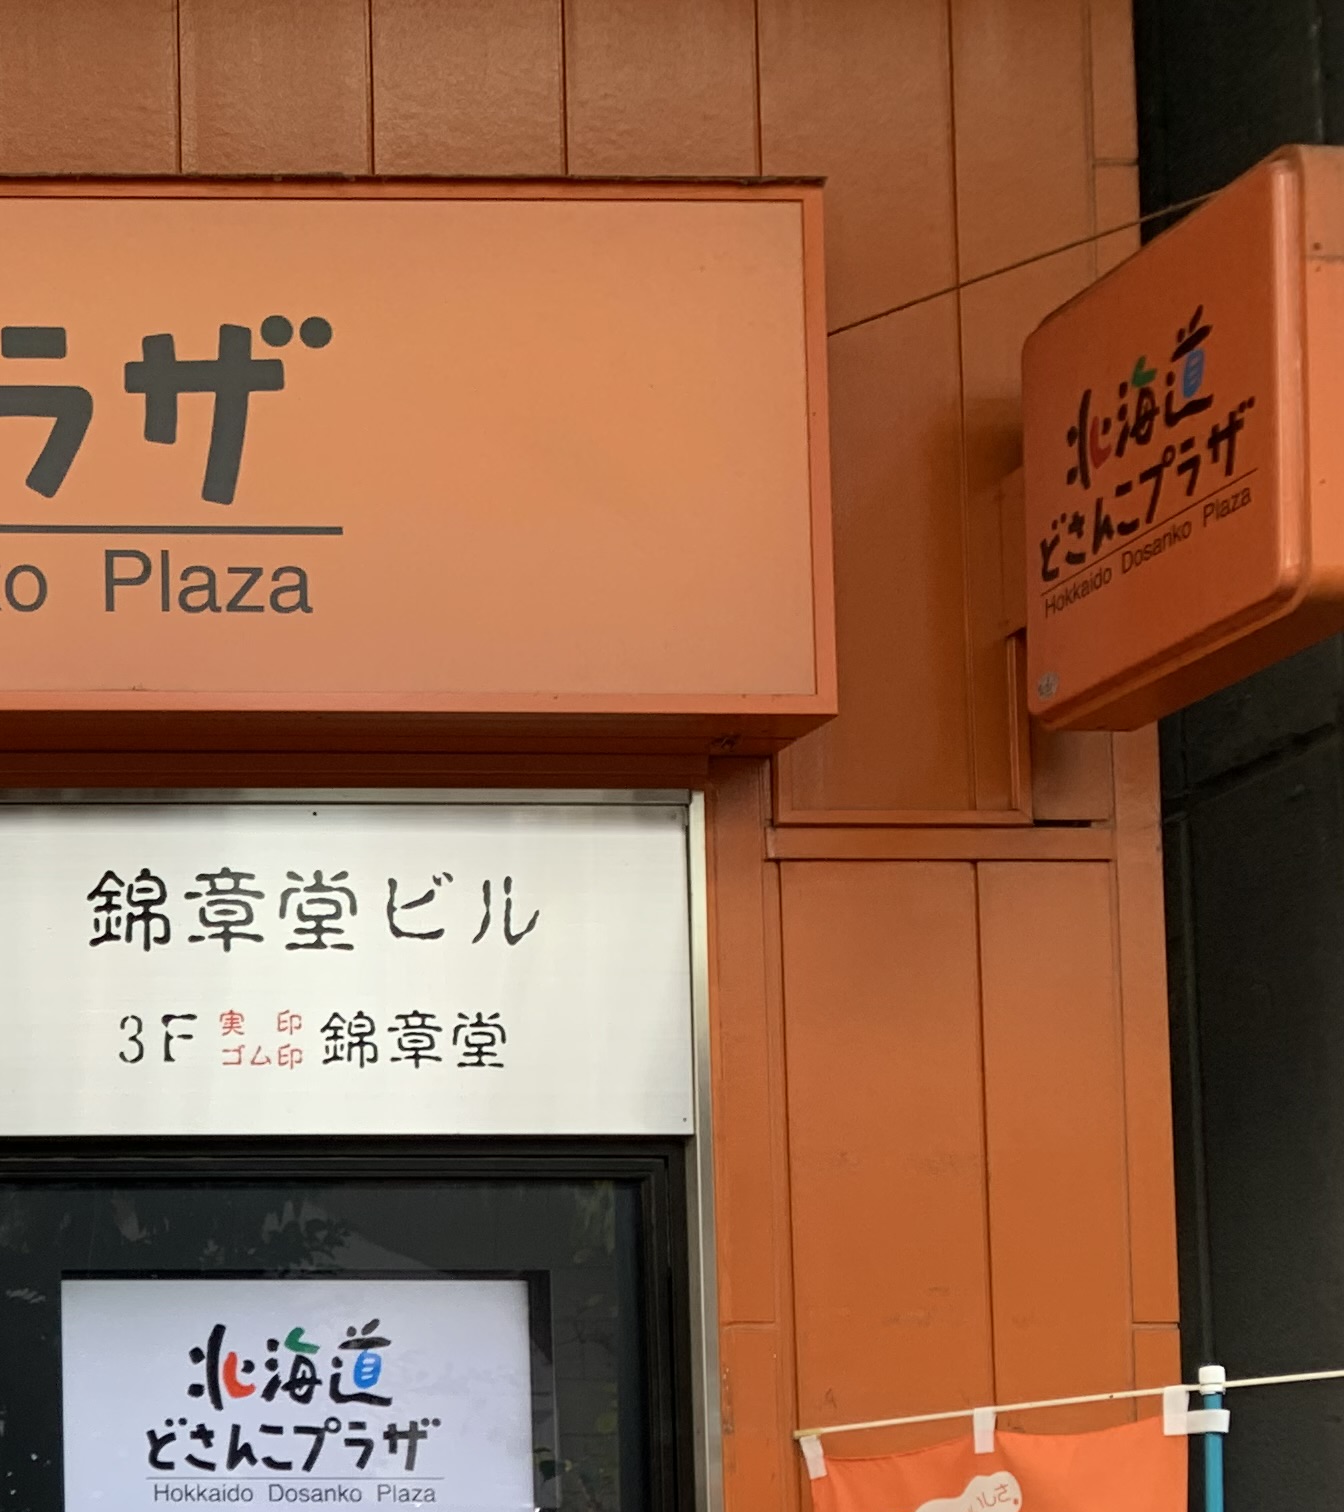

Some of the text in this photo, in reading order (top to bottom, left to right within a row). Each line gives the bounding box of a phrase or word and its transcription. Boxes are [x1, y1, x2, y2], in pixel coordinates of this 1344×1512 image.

[1066, 304, 1214, 490] 北海道
[1039, 396, 1256, 582] どさんこプラザ
[105, 548, 314, 614] Plaza
[1045, 486, 1252, 618] Hokkaido Dosanko Plaza
[86, 866, 540, 953] 錦章堂ビル
[119, 1013, 198, 1065] 3F
[219, 1042, 303, 1070] ゴム印
[319, 1010, 507, 1070] 錦章堂
[187, 1318, 393, 1411] 北海道
[146, 1416, 442, 1473] どさんこプラザ
[154, 1484, 437, 1503] Hokkaido Dosanko Plaza
